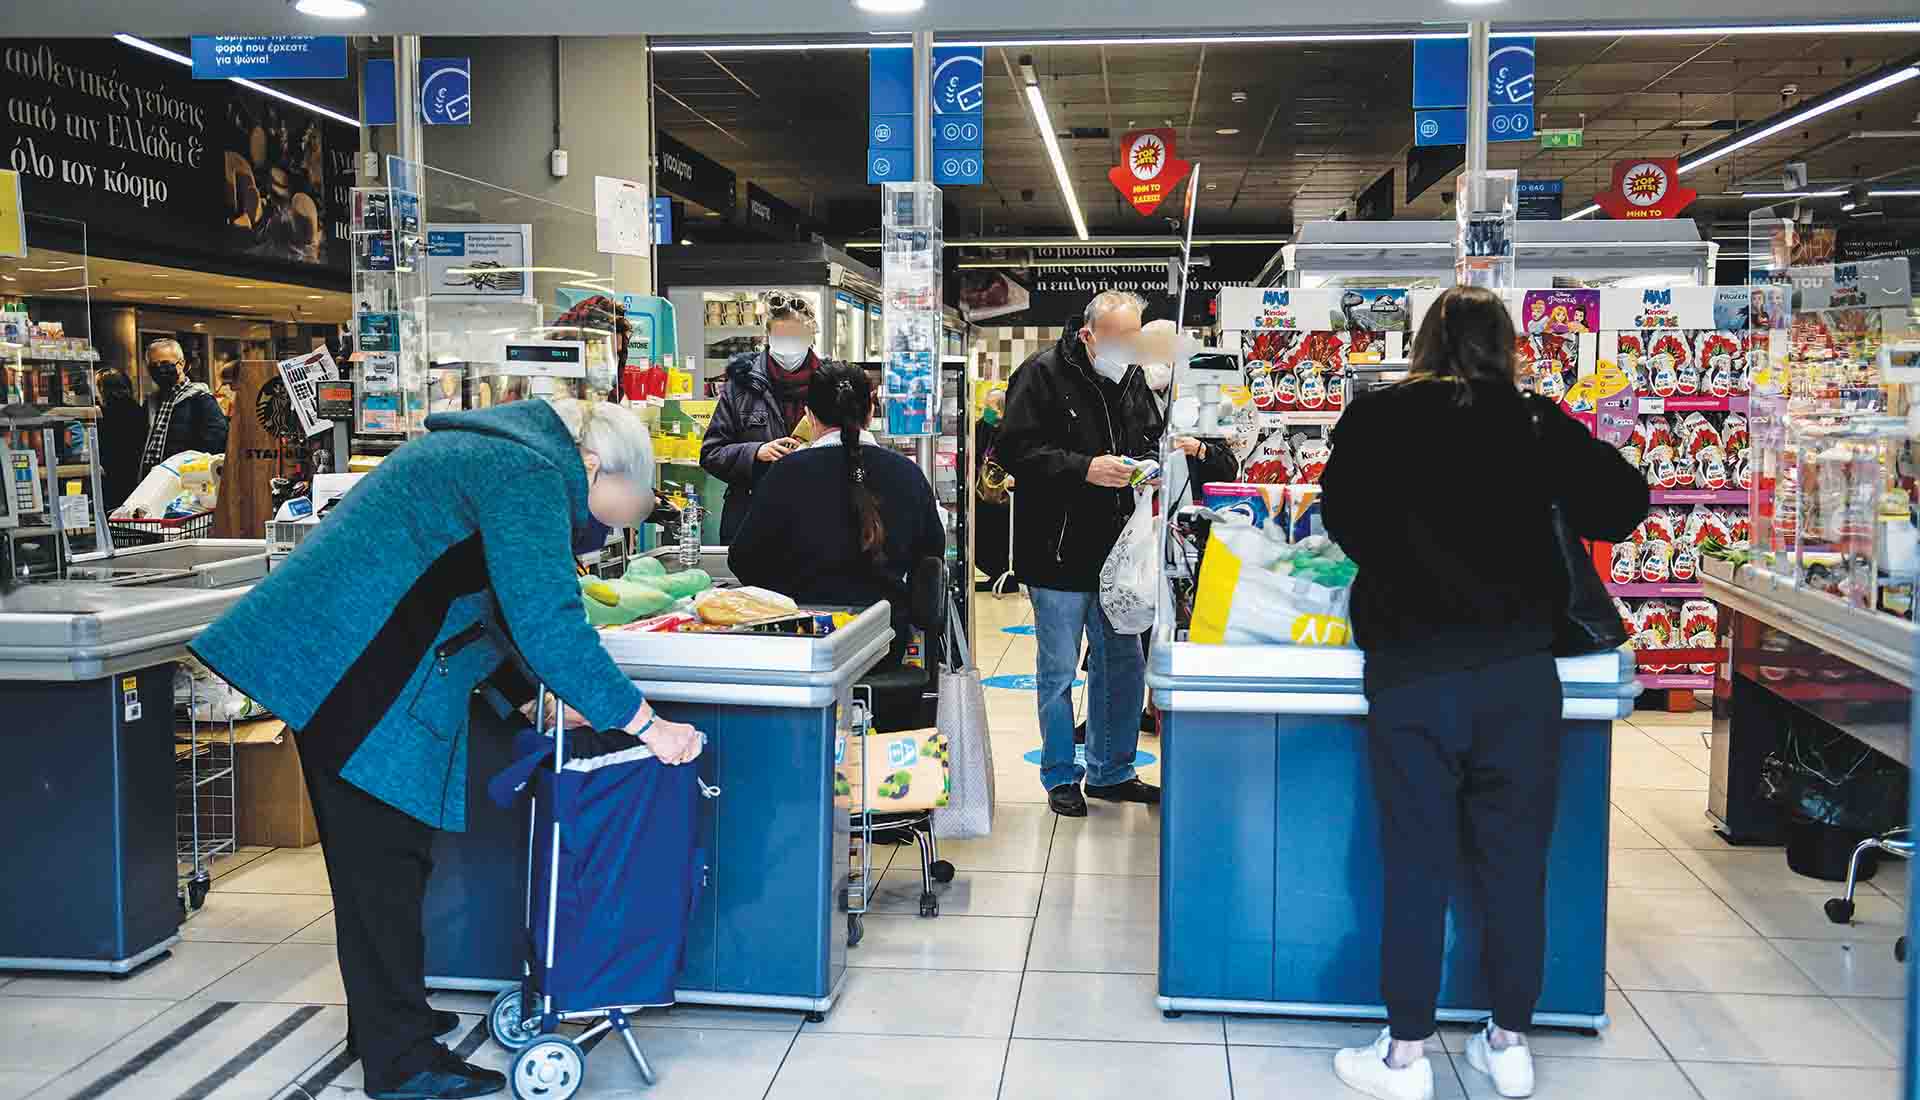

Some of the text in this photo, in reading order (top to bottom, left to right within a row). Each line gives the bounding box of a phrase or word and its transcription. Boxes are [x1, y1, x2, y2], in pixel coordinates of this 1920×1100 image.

[215, 43, 308, 55] φορά που έρχεστε
[215, 55, 269, 66] για ψώνια!
[107, 113, 184, 164] Ελλάδα
[187, 134, 204, 169] &
[10, 136, 168, 208] όλο τον κόσμο
[1634, 177, 1655, 186] TOP
[1528, 184, 1545, 192] BAG
[1263, 308, 1288, 317] Kinder
[1644, 308, 1669, 316] Kinder
